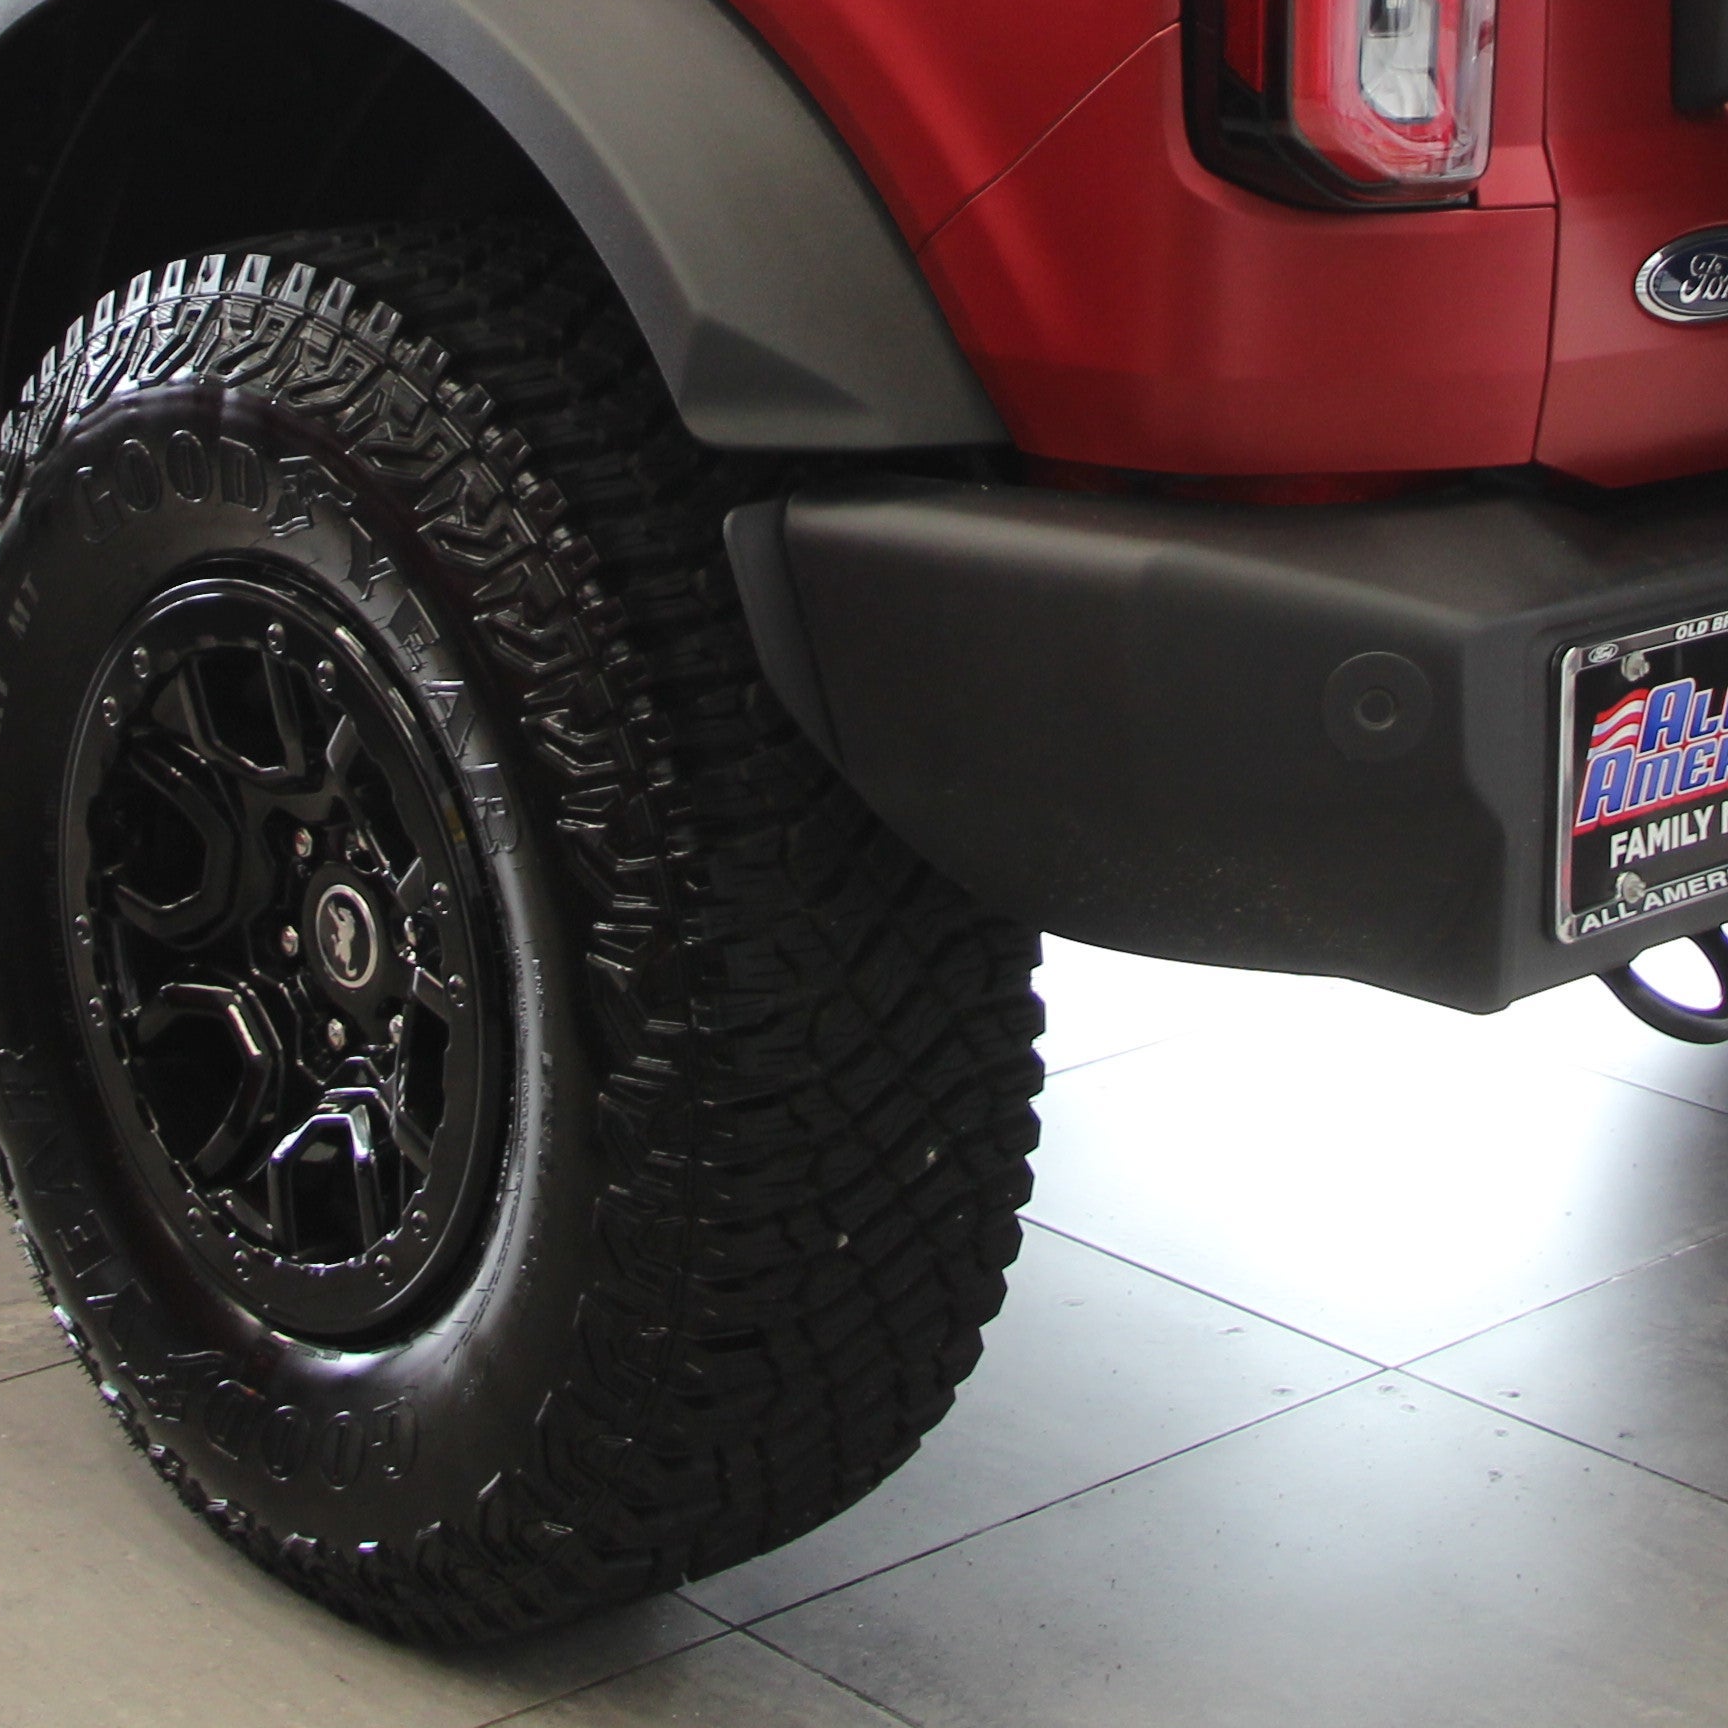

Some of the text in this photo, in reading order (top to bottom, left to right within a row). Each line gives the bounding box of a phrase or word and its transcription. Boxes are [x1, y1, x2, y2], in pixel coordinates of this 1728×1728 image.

[1675, 619, 1708, 641] OLD
[1609, 803, 1717, 869] FAMILY
[1580, 898, 1639, 934] ALL
